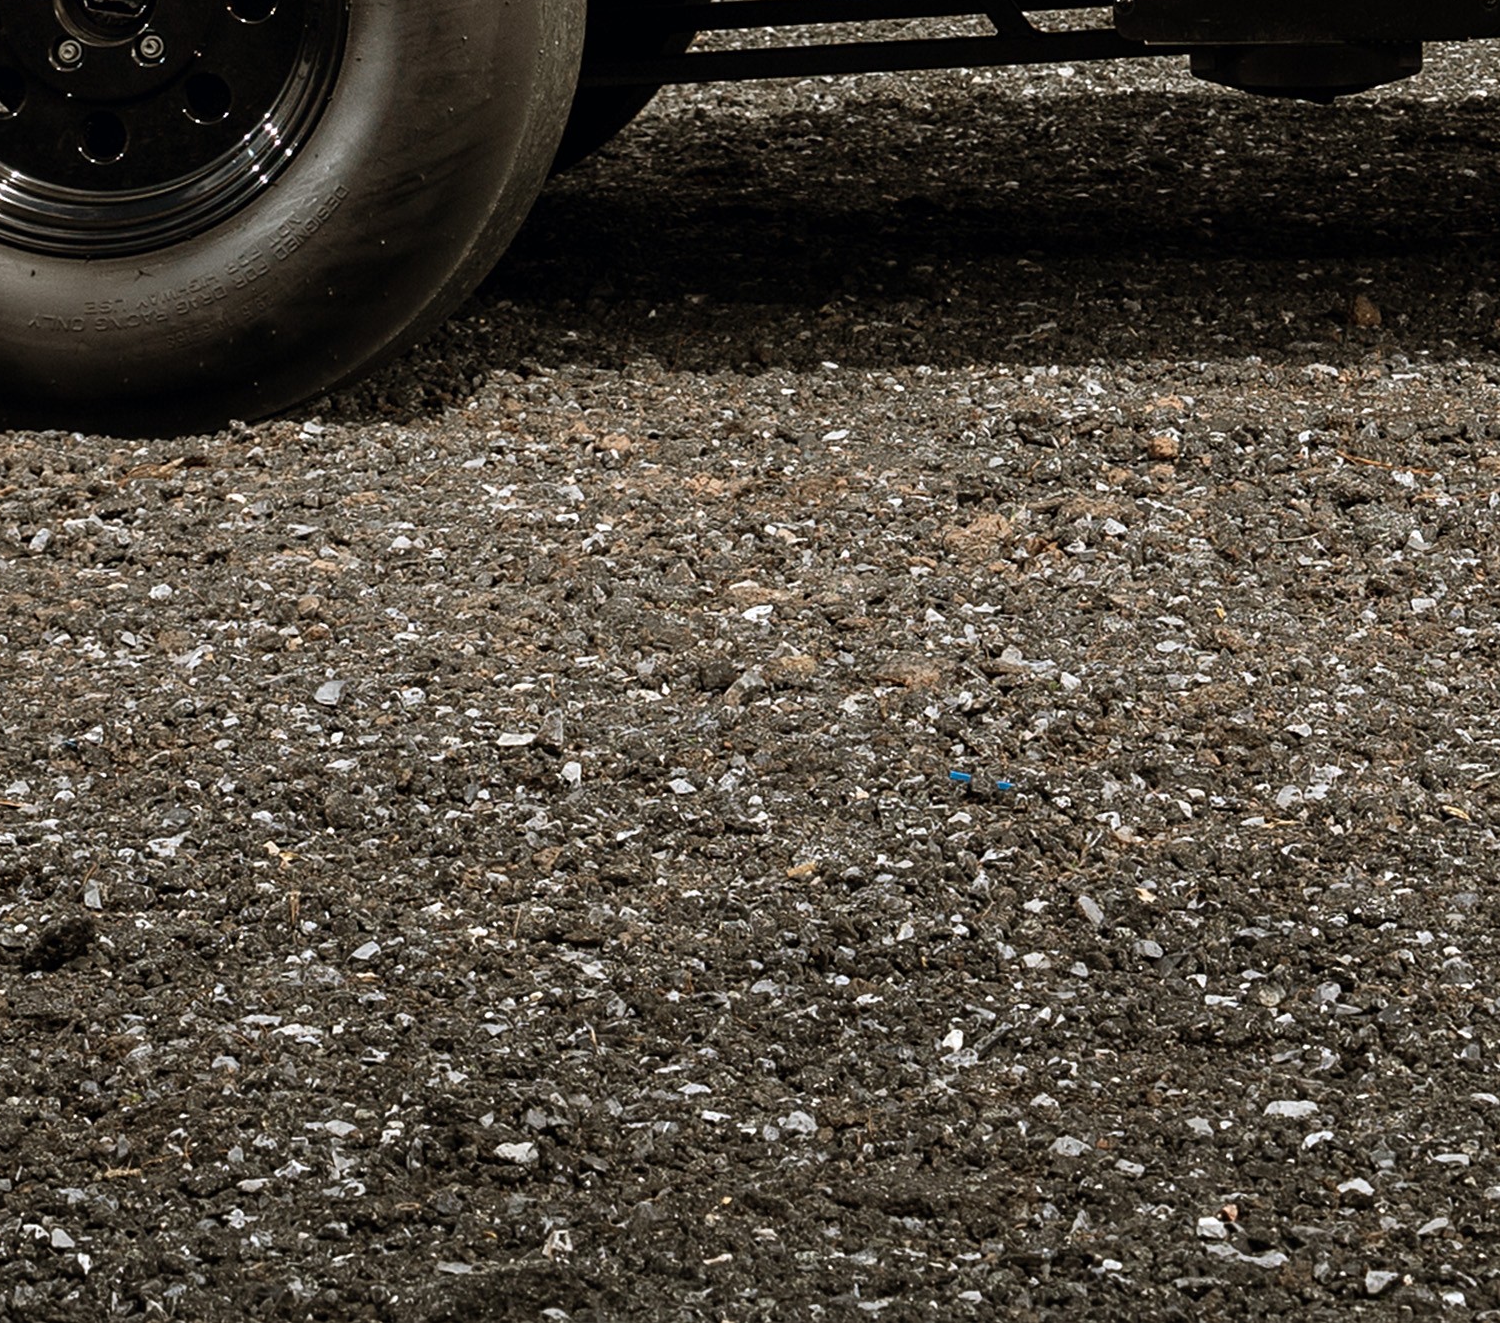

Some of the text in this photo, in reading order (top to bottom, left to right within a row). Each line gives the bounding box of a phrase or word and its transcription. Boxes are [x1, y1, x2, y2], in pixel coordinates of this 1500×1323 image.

[26, 183, 350, 333] DESIGNED FOR DRAG RACING ONLY
